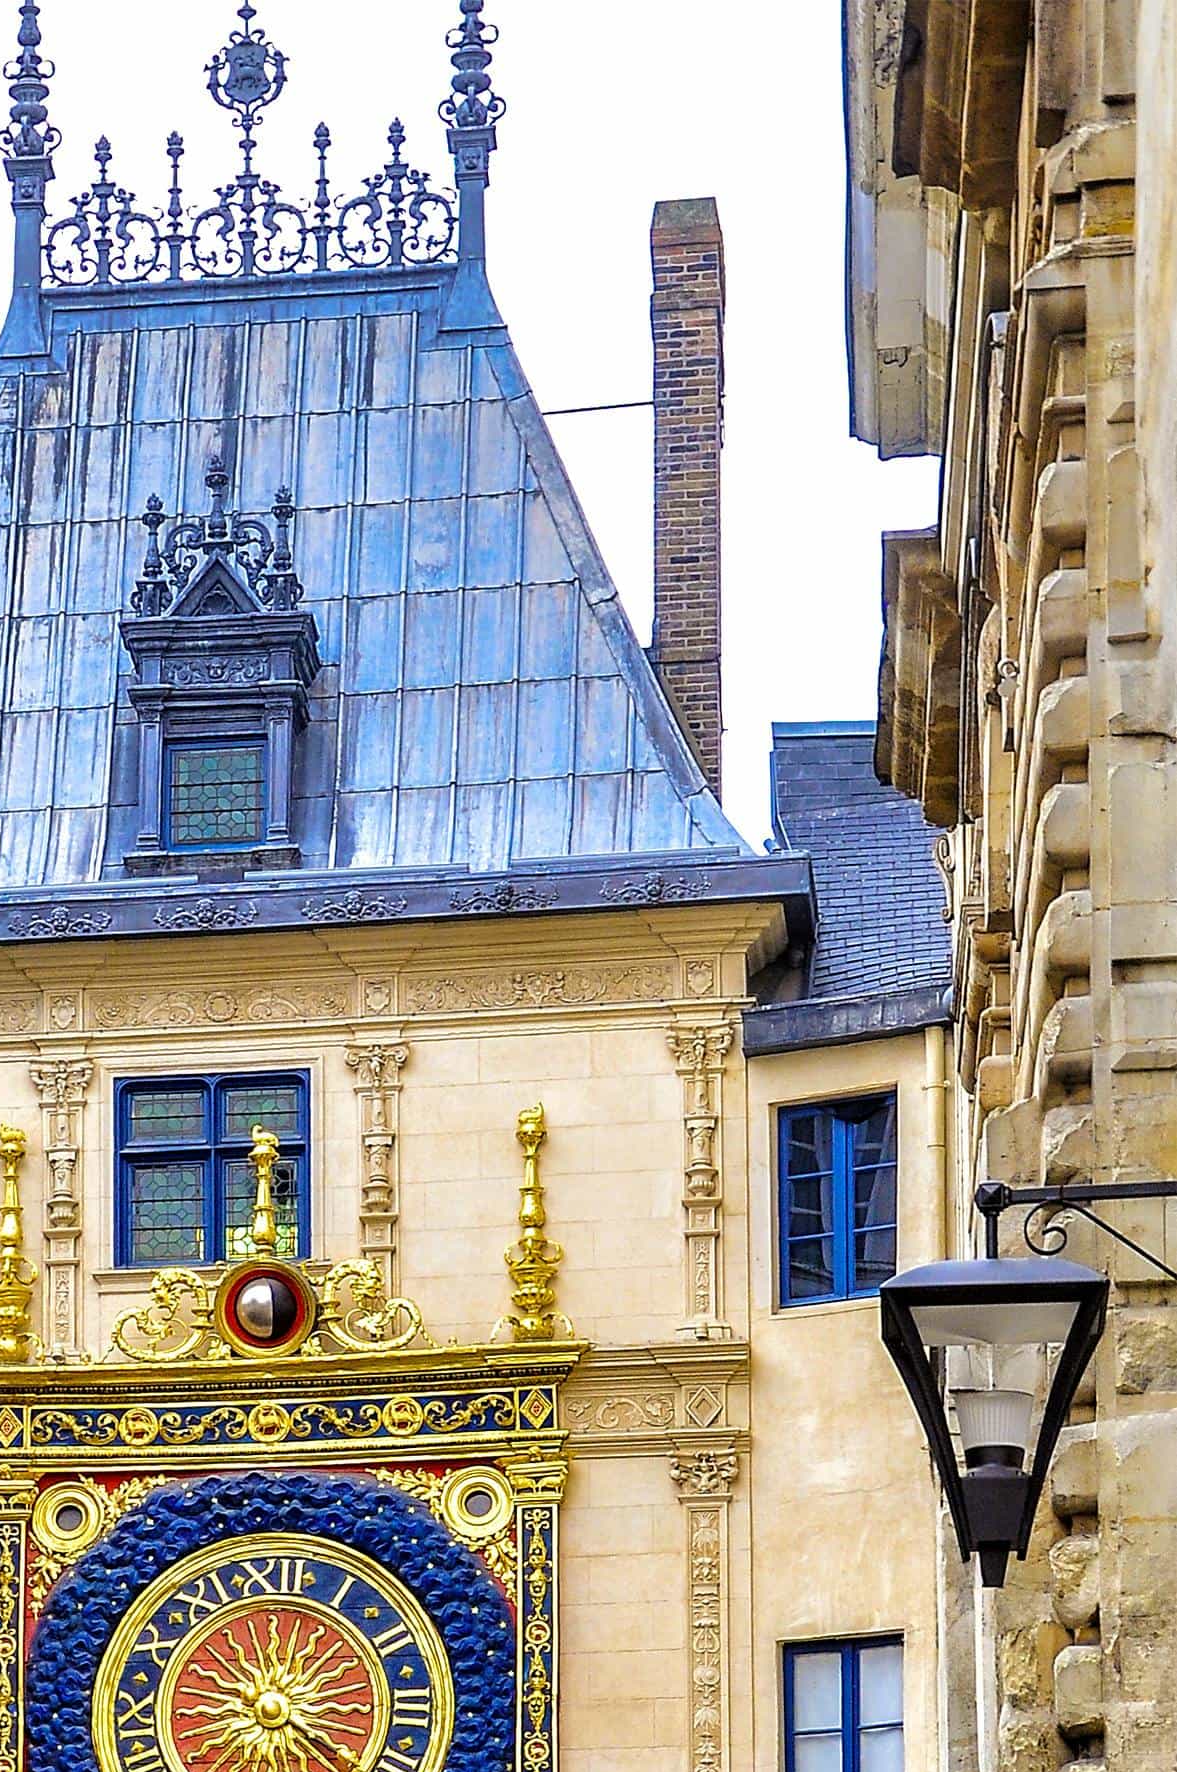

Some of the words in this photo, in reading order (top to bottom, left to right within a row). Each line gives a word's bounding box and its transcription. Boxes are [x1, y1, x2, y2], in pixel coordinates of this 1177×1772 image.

[175, 1570, 233, 1626] XI
[240, 1558, 305, 1597] XII
[328, 1574, 357, 1609] I
[132, 1624, 181, 1668] X
[371, 1622, 415, 1658] II
[117, 1691, 156, 1741] IX
[393, 1687, 432, 1729] III
